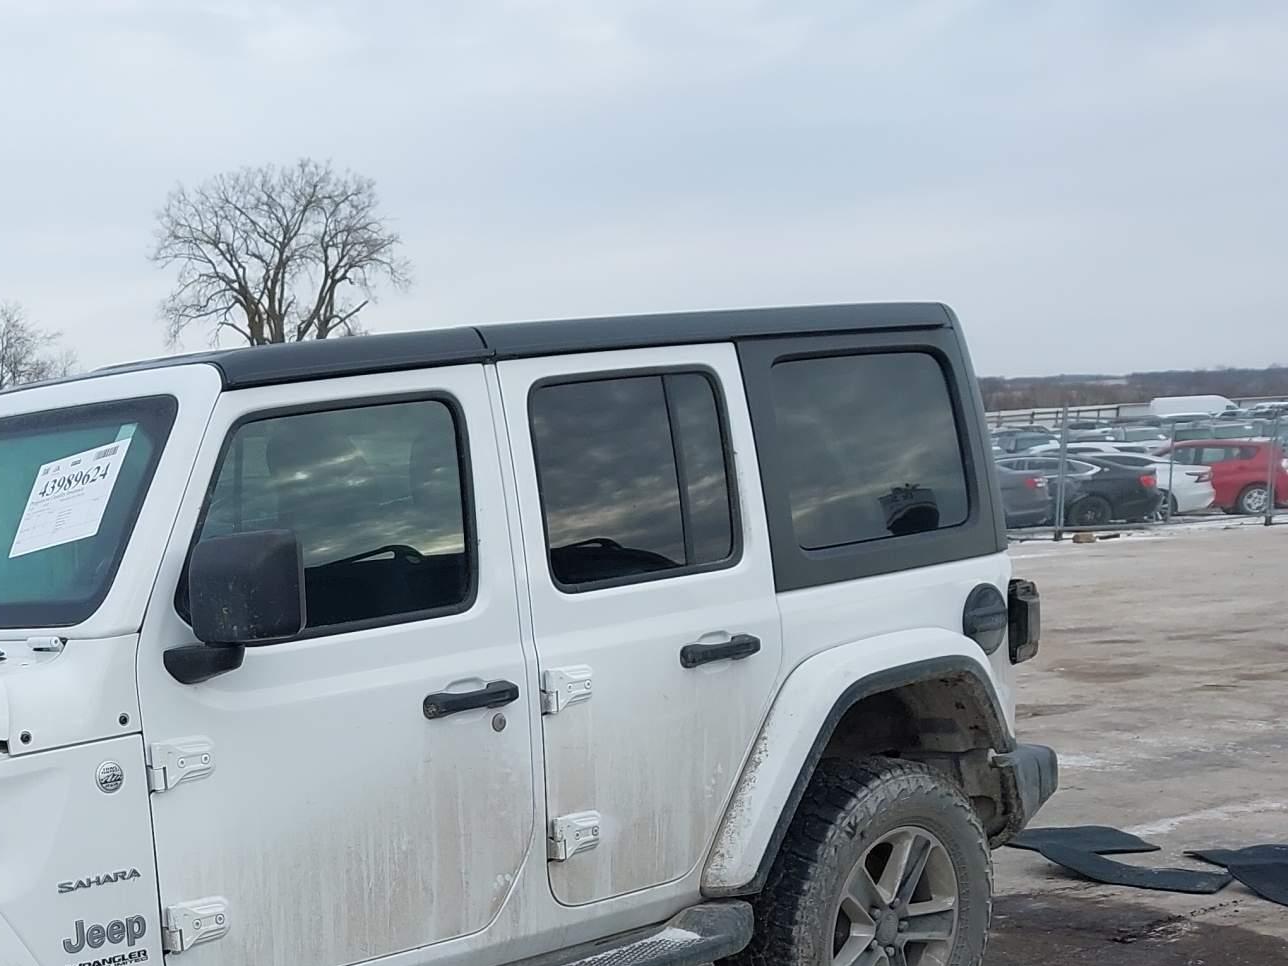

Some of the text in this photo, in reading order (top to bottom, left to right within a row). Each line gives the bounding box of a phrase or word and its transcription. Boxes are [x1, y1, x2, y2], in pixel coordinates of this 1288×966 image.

[39, 463, 110, 497] 43989624
[57, 868, 142, 894] SAHARA
[62, 914, 147, 954] Jeep
